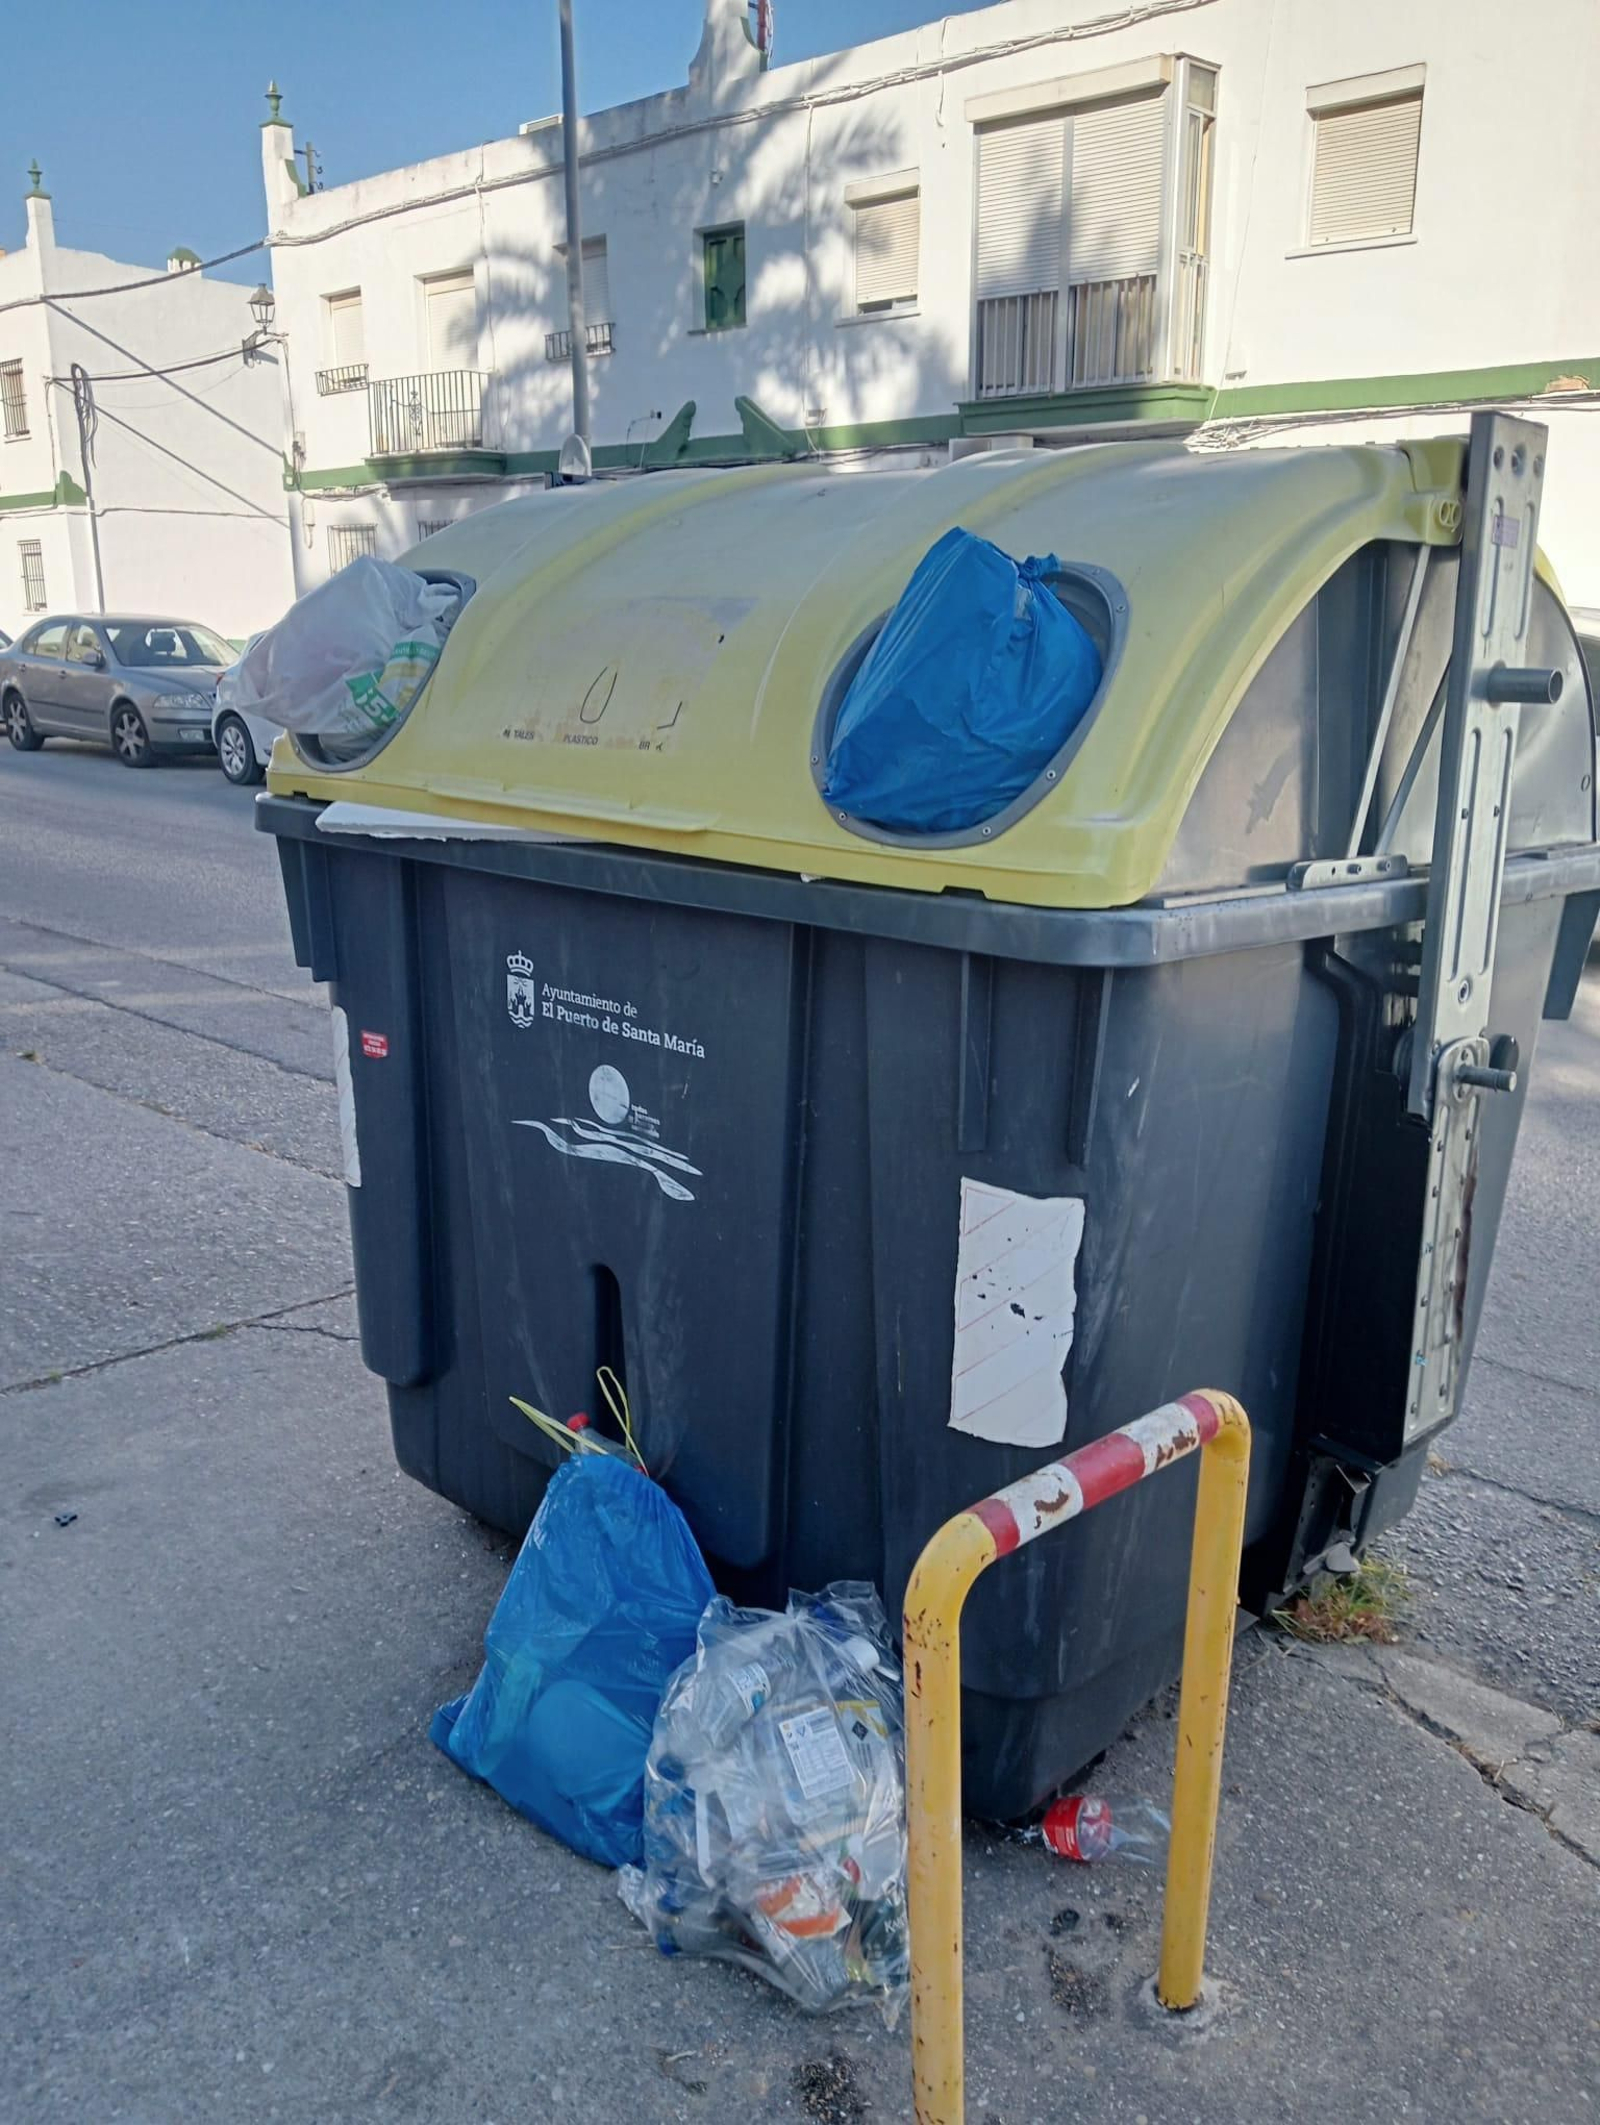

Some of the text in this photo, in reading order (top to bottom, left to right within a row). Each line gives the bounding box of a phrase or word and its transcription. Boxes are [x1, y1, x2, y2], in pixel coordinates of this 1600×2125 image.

[541, 982, 638, 1019] Ayuntamiento de
[541, 1001, 706, 1059] El Puerto de Santa María
